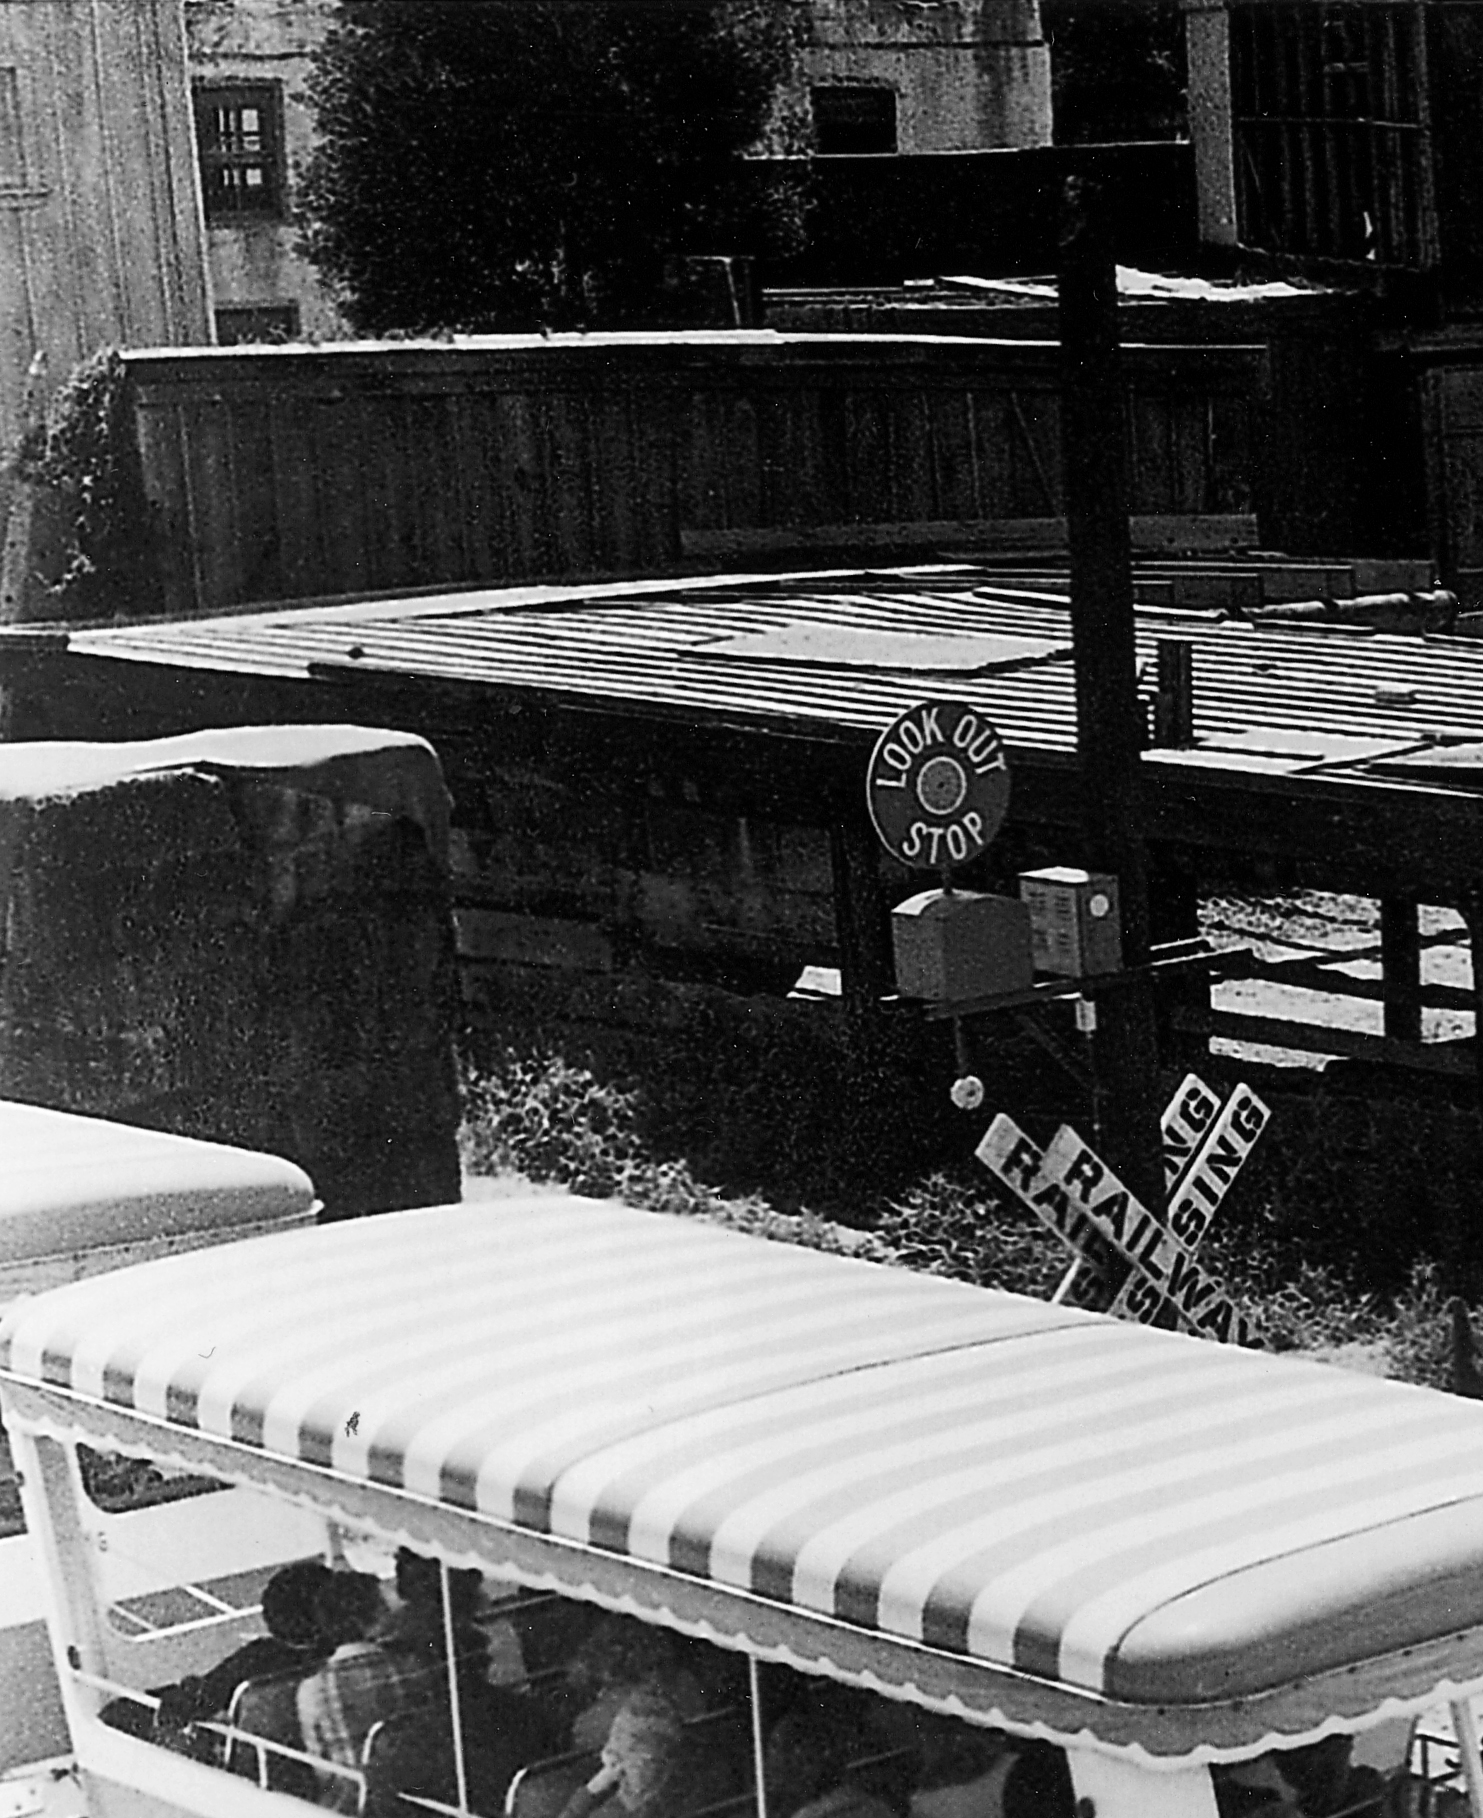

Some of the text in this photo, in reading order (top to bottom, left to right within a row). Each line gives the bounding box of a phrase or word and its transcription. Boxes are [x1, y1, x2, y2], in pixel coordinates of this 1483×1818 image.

[875, 706, 1008, 788] LOOK OUT
[901, 811, 984, 865] STOP
